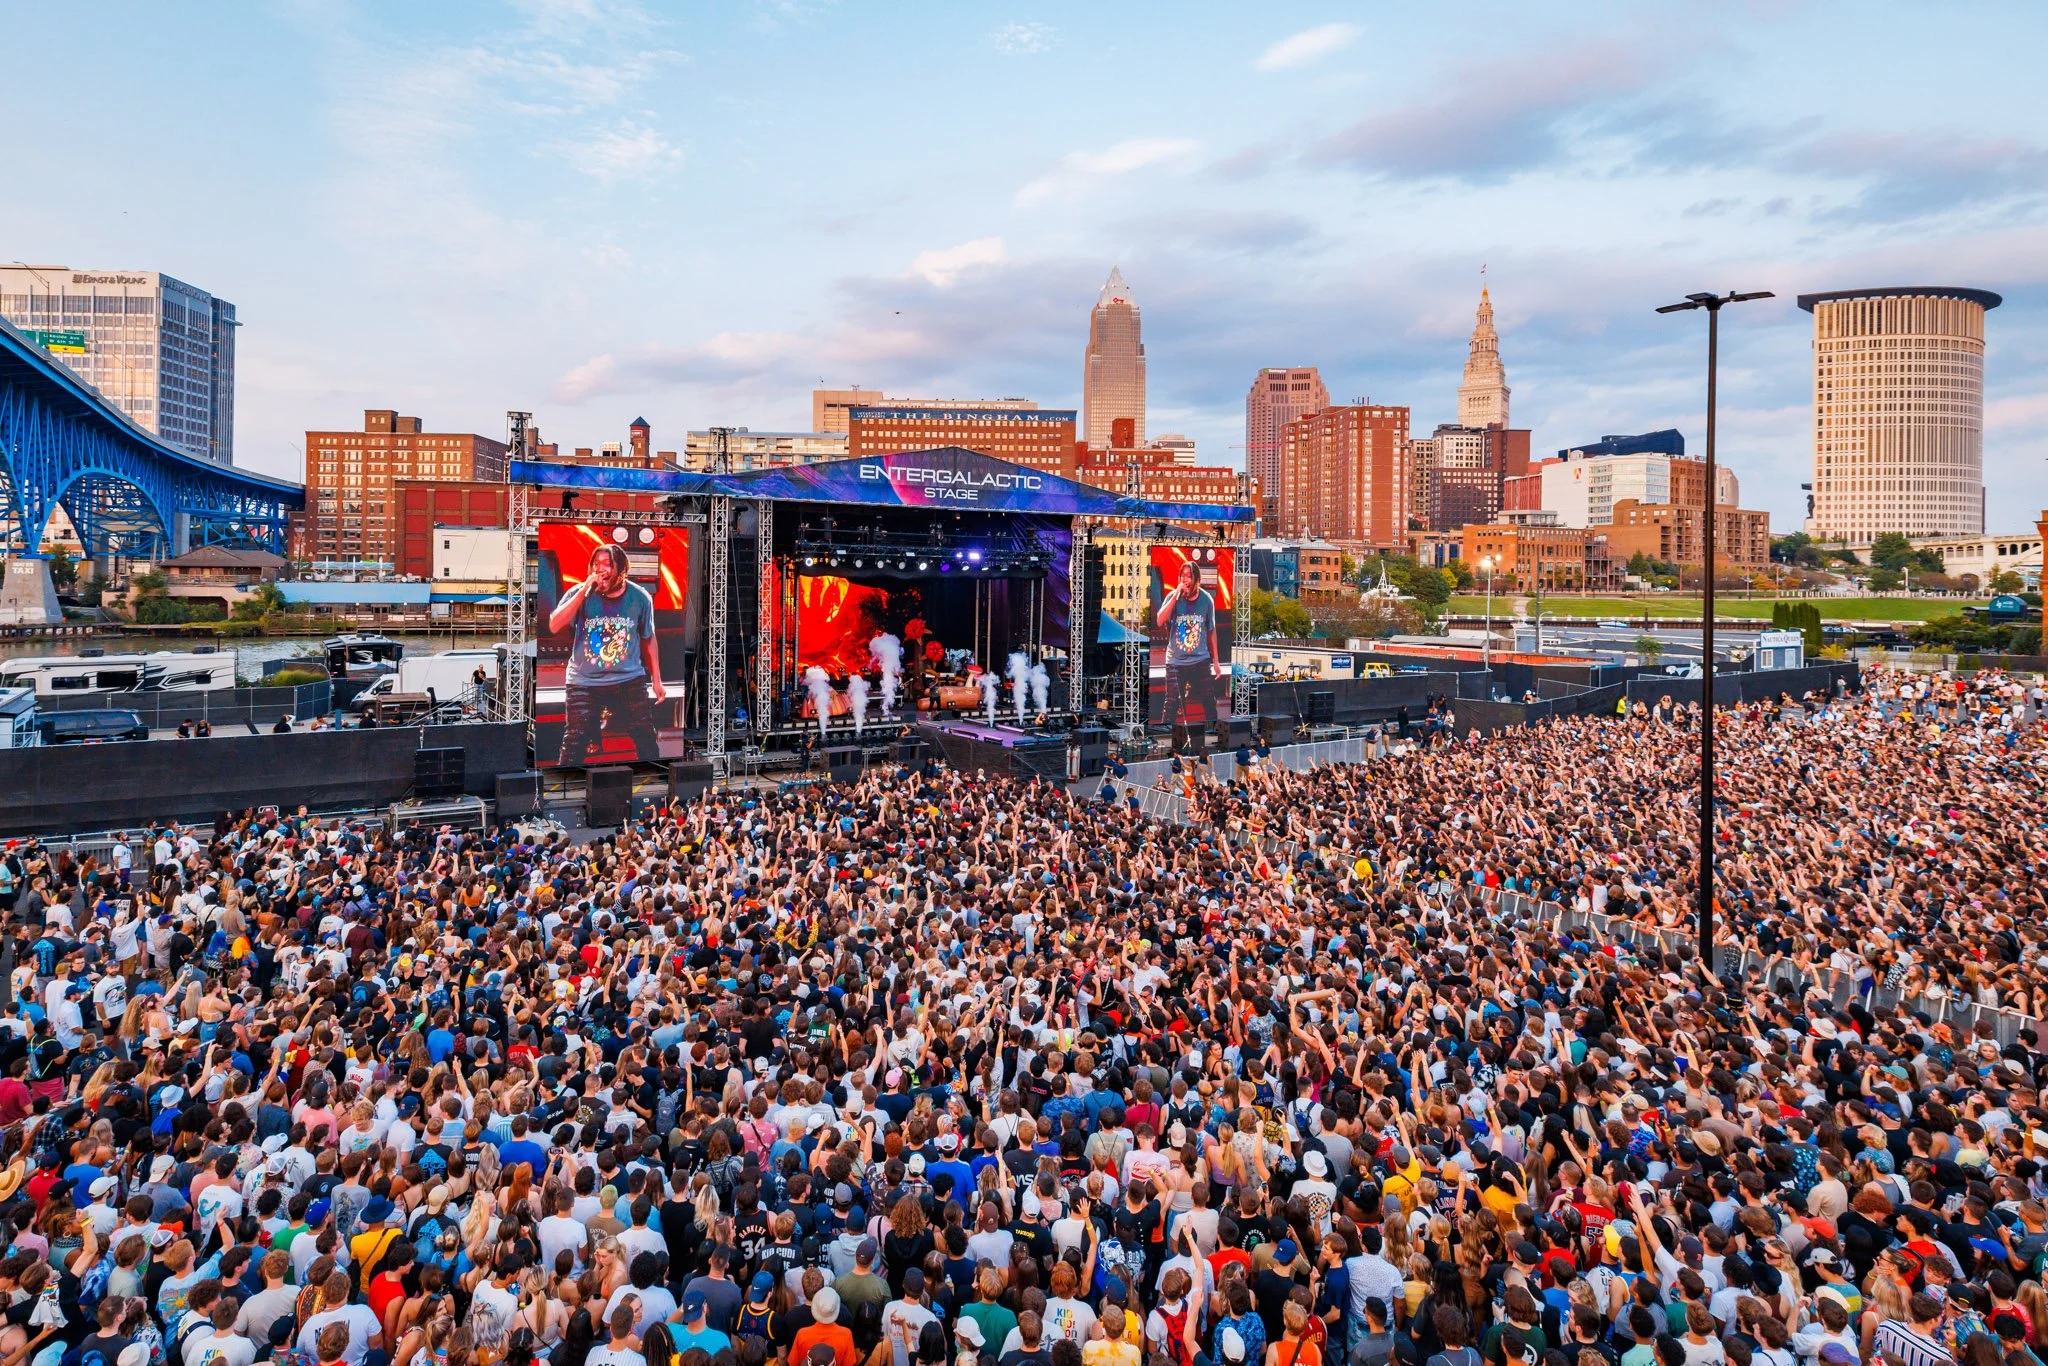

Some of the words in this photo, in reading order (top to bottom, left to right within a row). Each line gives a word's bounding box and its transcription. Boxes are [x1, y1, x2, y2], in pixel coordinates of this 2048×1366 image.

[943, 413, 1040, 421] BINGHAM
[859, 464, 1042, 490] ENTERGALACTIC
[924, 487, 978, 500] STAGE
[1436, 1196, 1468, 1211] LINDR
[739, 1224, 767, 1239] BARKLEY
[740, 1236, 766, 1260] 34
[762, 1248, 774, 1260] KID
[776, 1247, 795, 1259] CUDI
[1057, 1308, 1073, 1319] KID
